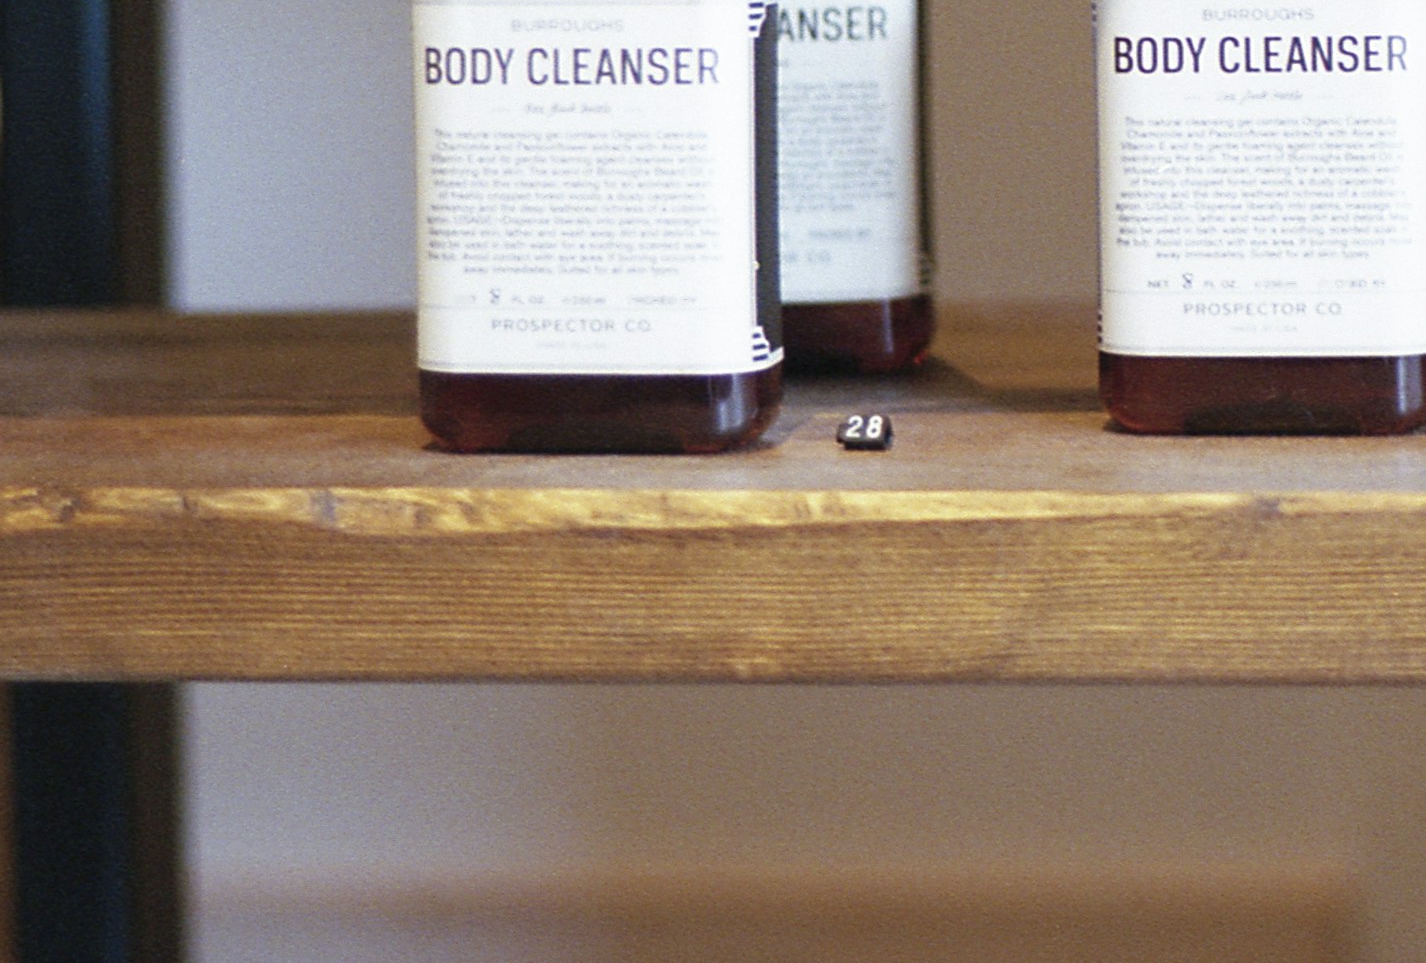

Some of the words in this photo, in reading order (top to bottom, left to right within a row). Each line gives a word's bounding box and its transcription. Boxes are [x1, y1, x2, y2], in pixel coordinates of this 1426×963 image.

[777, 6, 888, 40] ANSER
[1202, 9, 1314, 22] BURROUGHS
[1113, 36, 1206, 74] BODY
[1218, 35, 1409, 73] CLEANSER
[424, 47, 515, 86] BODY
[527, 47, 720, 85] CLEANSER
[1182, 302, 1307, 316] PROSPECTOR
[490, 318, 616, 333] PROSPECTOR
[845, 415, 883, 438] 28
